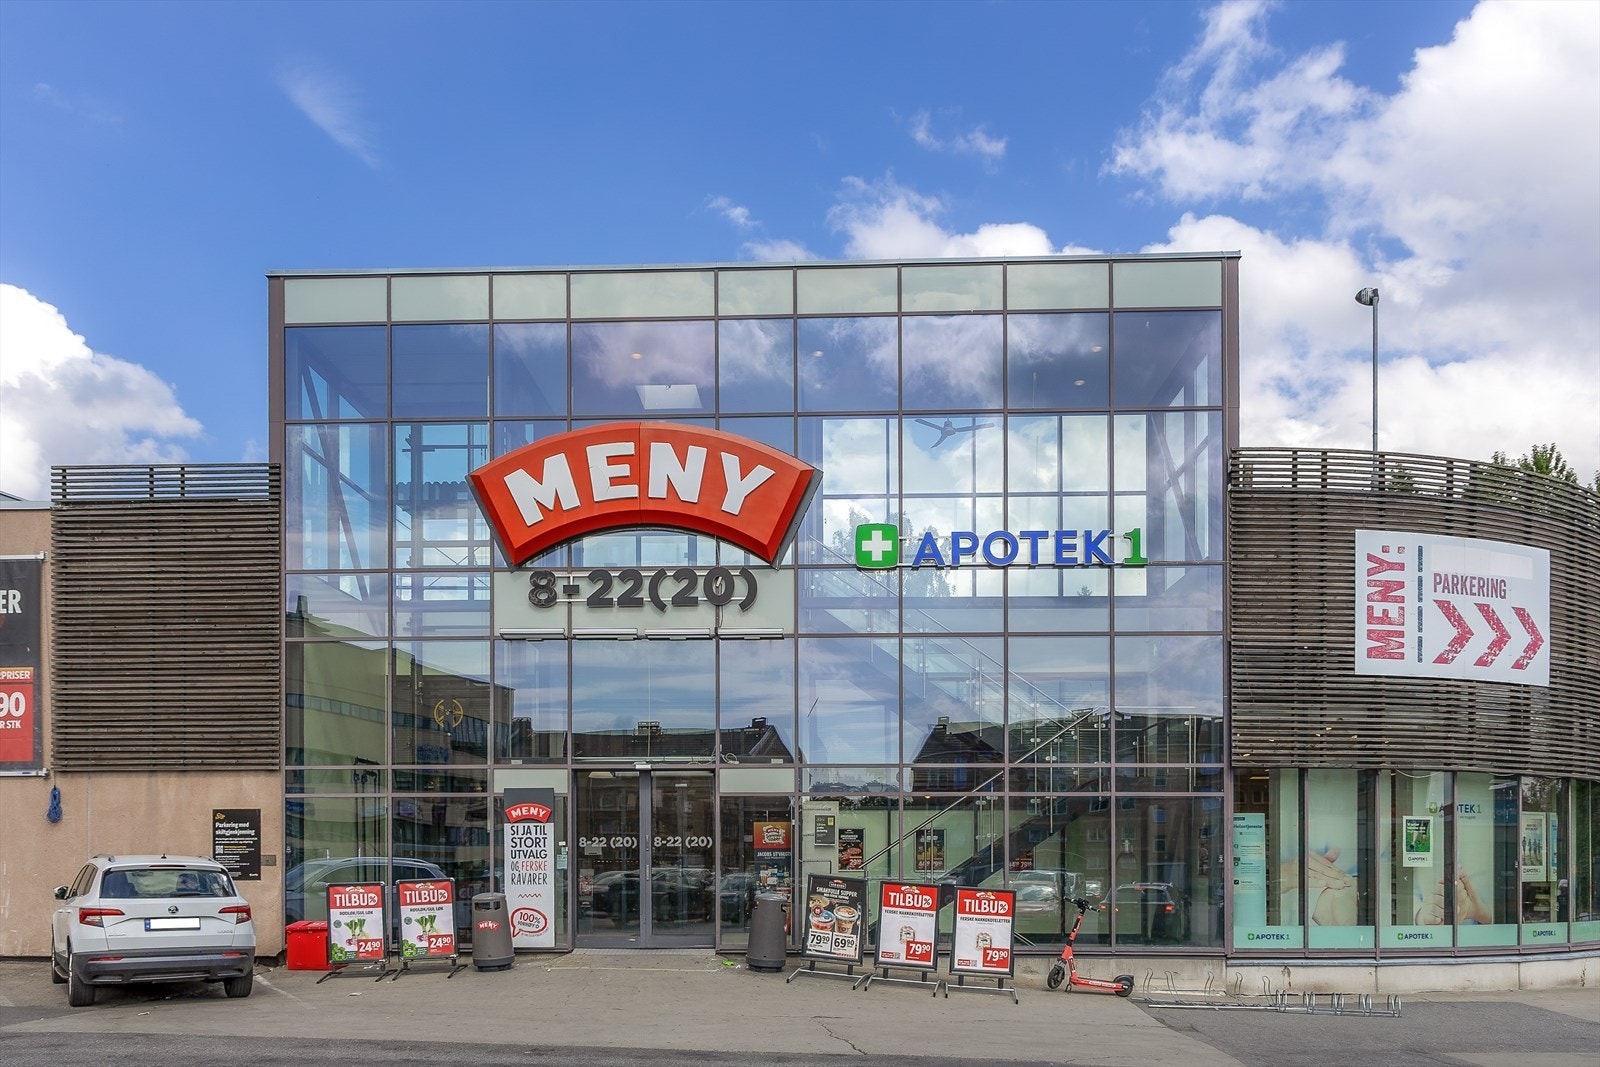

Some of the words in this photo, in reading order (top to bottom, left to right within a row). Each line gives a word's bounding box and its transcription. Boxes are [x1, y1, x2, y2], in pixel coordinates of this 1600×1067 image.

[504, 441, 776, 527] MENY
[911, 529, 1115, 567] APOTEK
[1123, 528, 1149, 565] 1
[1433, 572, 1507, 599] PARKERING
[1366, 544, 1406, 661] MENY:
[0, 670, 31, 680] PRISER
[6, 720, 22, 729] STK
[510, 806, 547, 818] MENY
[215, 821, 238, 829] Parkering
[510, 825, 519, 836] SI
[521, 825, 532, 836] JA
[533, 825, 547, 836] TIL
[510, 837, 548, 848] STORT
[578, 836, 607, 848] 8-22
[610, 836, 638, 849] (20)
[653, 836, 682, 848] 8-22
[685, 836, 713, 848] (20)
[510, 849, 548, 860] UTVALG
[510, 861, 519, 872] OG
[521, 860, 548, 872] FERSKE
[511, 870, 548, 885] RÅVARER
[333, 893, 378, 907] TILBUD
[404, 889, 448, 904] TILBUD
[840, 889, 858, 898] SUPPER
[888, 892, 933, 908] TILBUD
[963, 898, 1009, 914] TILBUD
[519, 912, 541, 925] 100%
